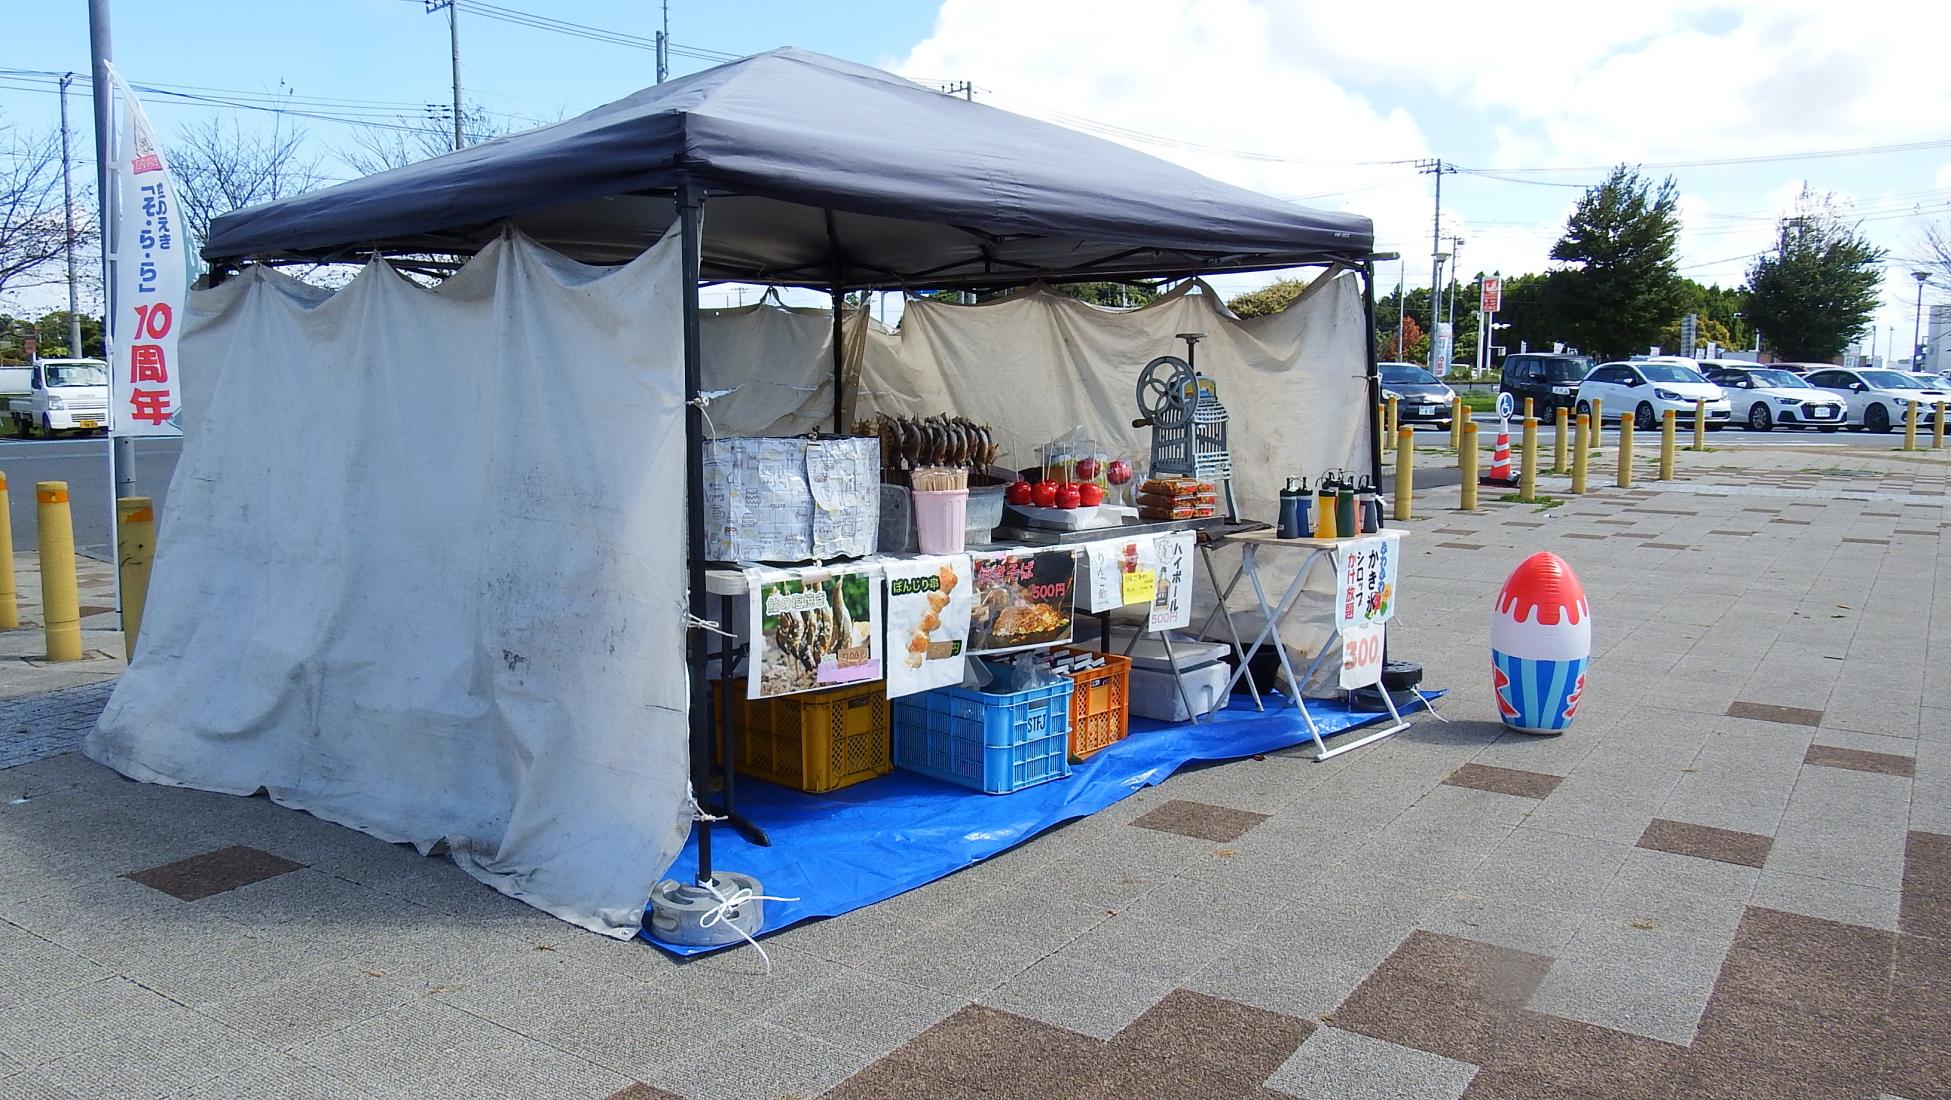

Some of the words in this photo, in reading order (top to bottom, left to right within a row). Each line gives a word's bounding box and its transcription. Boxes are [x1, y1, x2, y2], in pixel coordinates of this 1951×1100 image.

[130, 302, 173, 425] 10周年
[893, 578, 939, 593] ぽんじり串
[1170, 543, 1183, 612] ハイボール
[1031, 582, 1066, 600] 500円
[1151, 611, 1178, 625] 500円
[1028, 714, 1047, 733] STFJ
